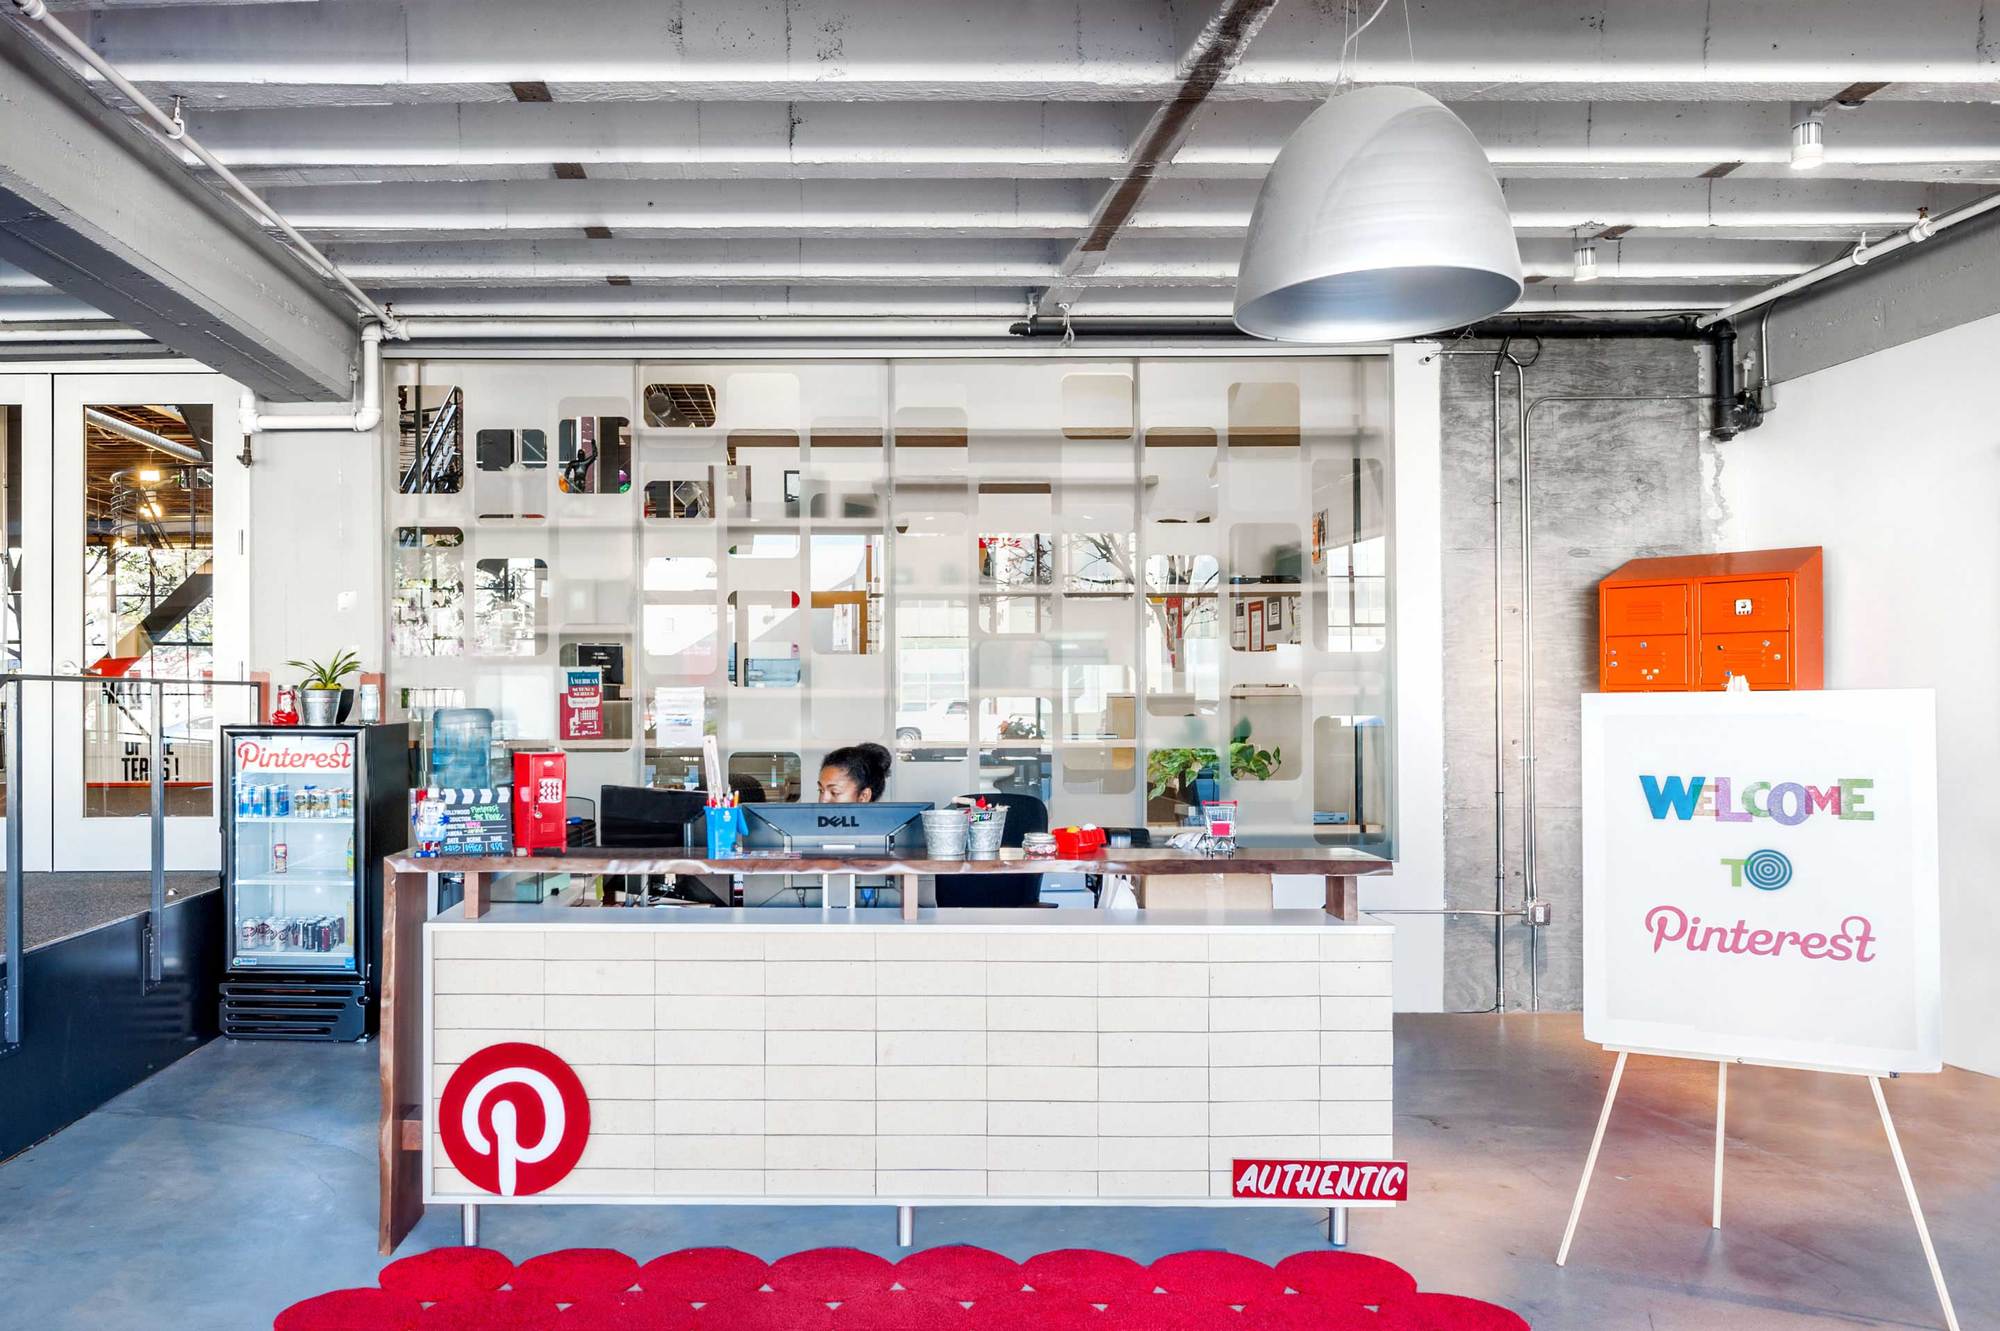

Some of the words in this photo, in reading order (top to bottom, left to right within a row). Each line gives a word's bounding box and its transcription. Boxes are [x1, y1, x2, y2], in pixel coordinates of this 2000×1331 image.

[570, 676, 599, 684] AMERICAN
[238, 742, 351, 770] Pinterest
[1639, 775, 1875, 826] WELCOME
[818, 816, 859, 827] DELL
[1720, 849, 1793, 890] TO
[1645, 905, 1876, 962] Pinterest
[1236, 1163, 1405, 1197] AUTHENTIC
